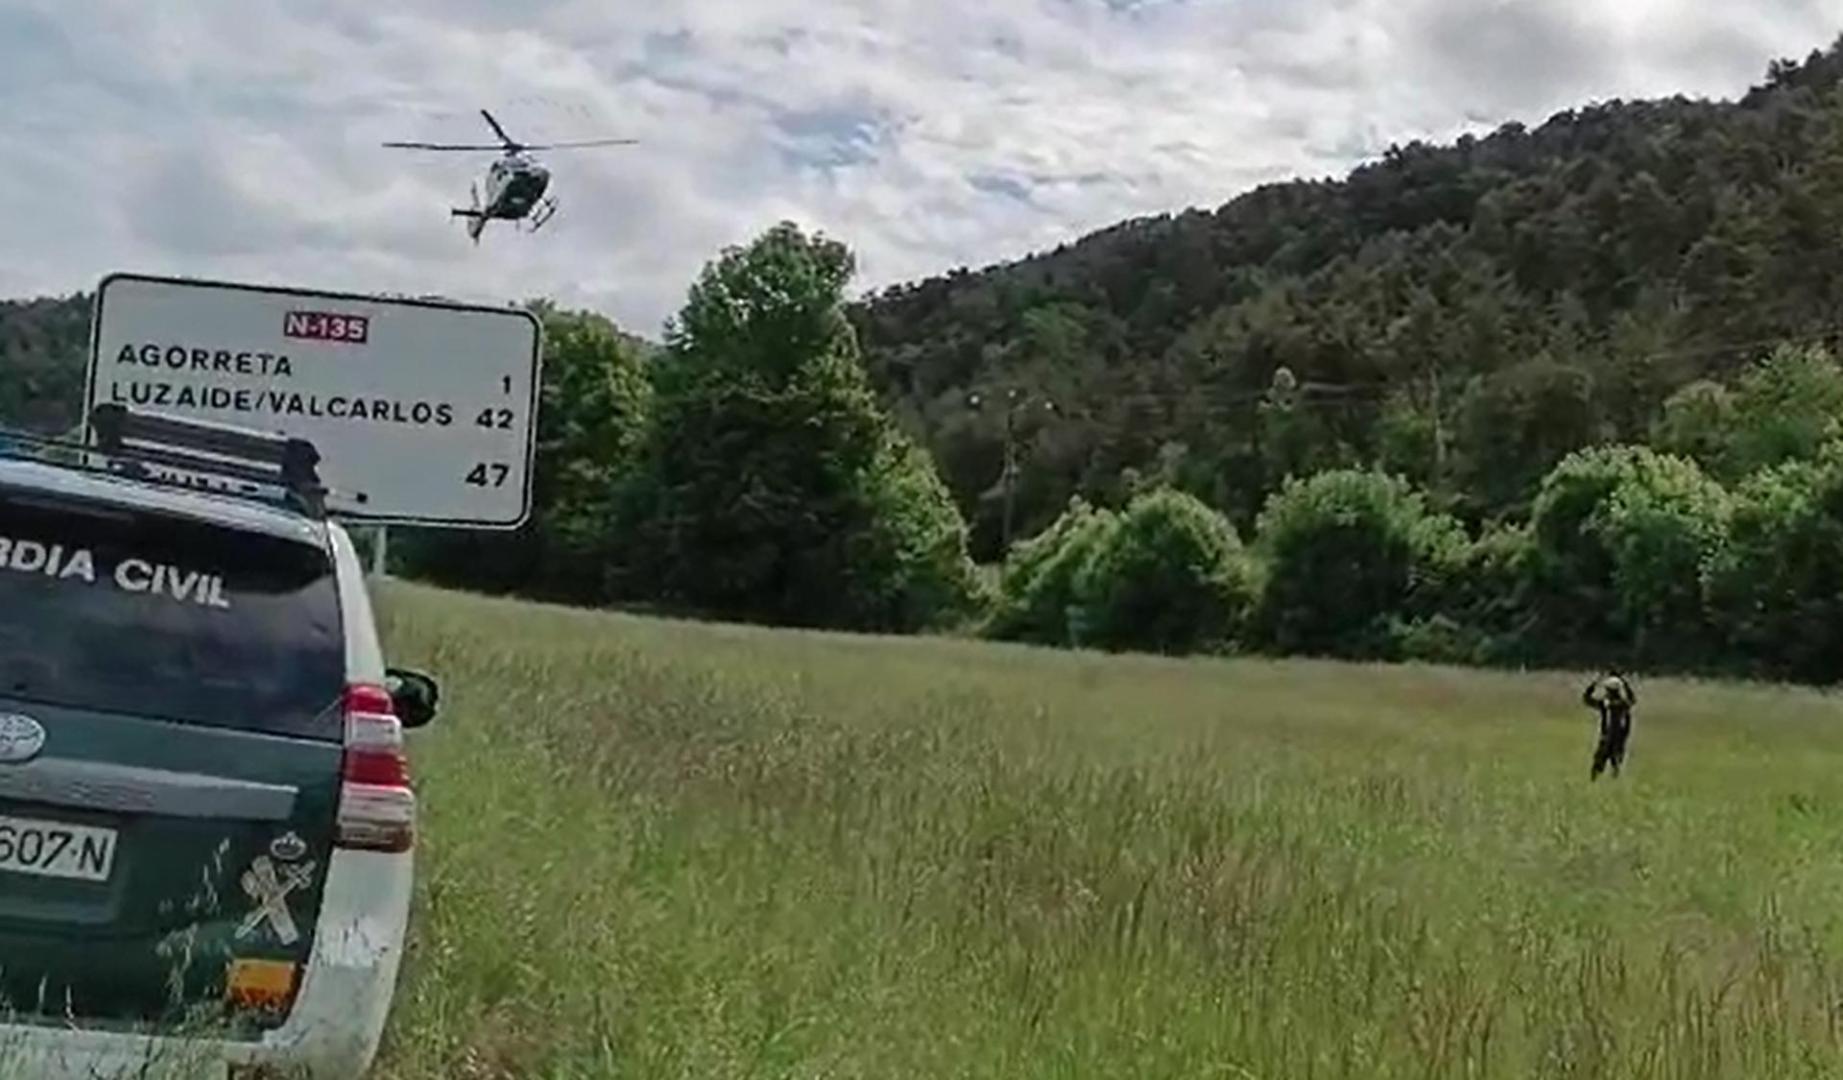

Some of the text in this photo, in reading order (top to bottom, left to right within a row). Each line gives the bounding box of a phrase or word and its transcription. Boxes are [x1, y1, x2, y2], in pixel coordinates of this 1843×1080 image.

[286, 313, 365, 340] N-135
[116, 343, 512, 395] AGORRETA 1
[111, 381, 514, 430] LUZAIDE/VALCARLOS 42
[465, 463, 509, 488] 47
[114, 558, 230, 607] CIVIL
